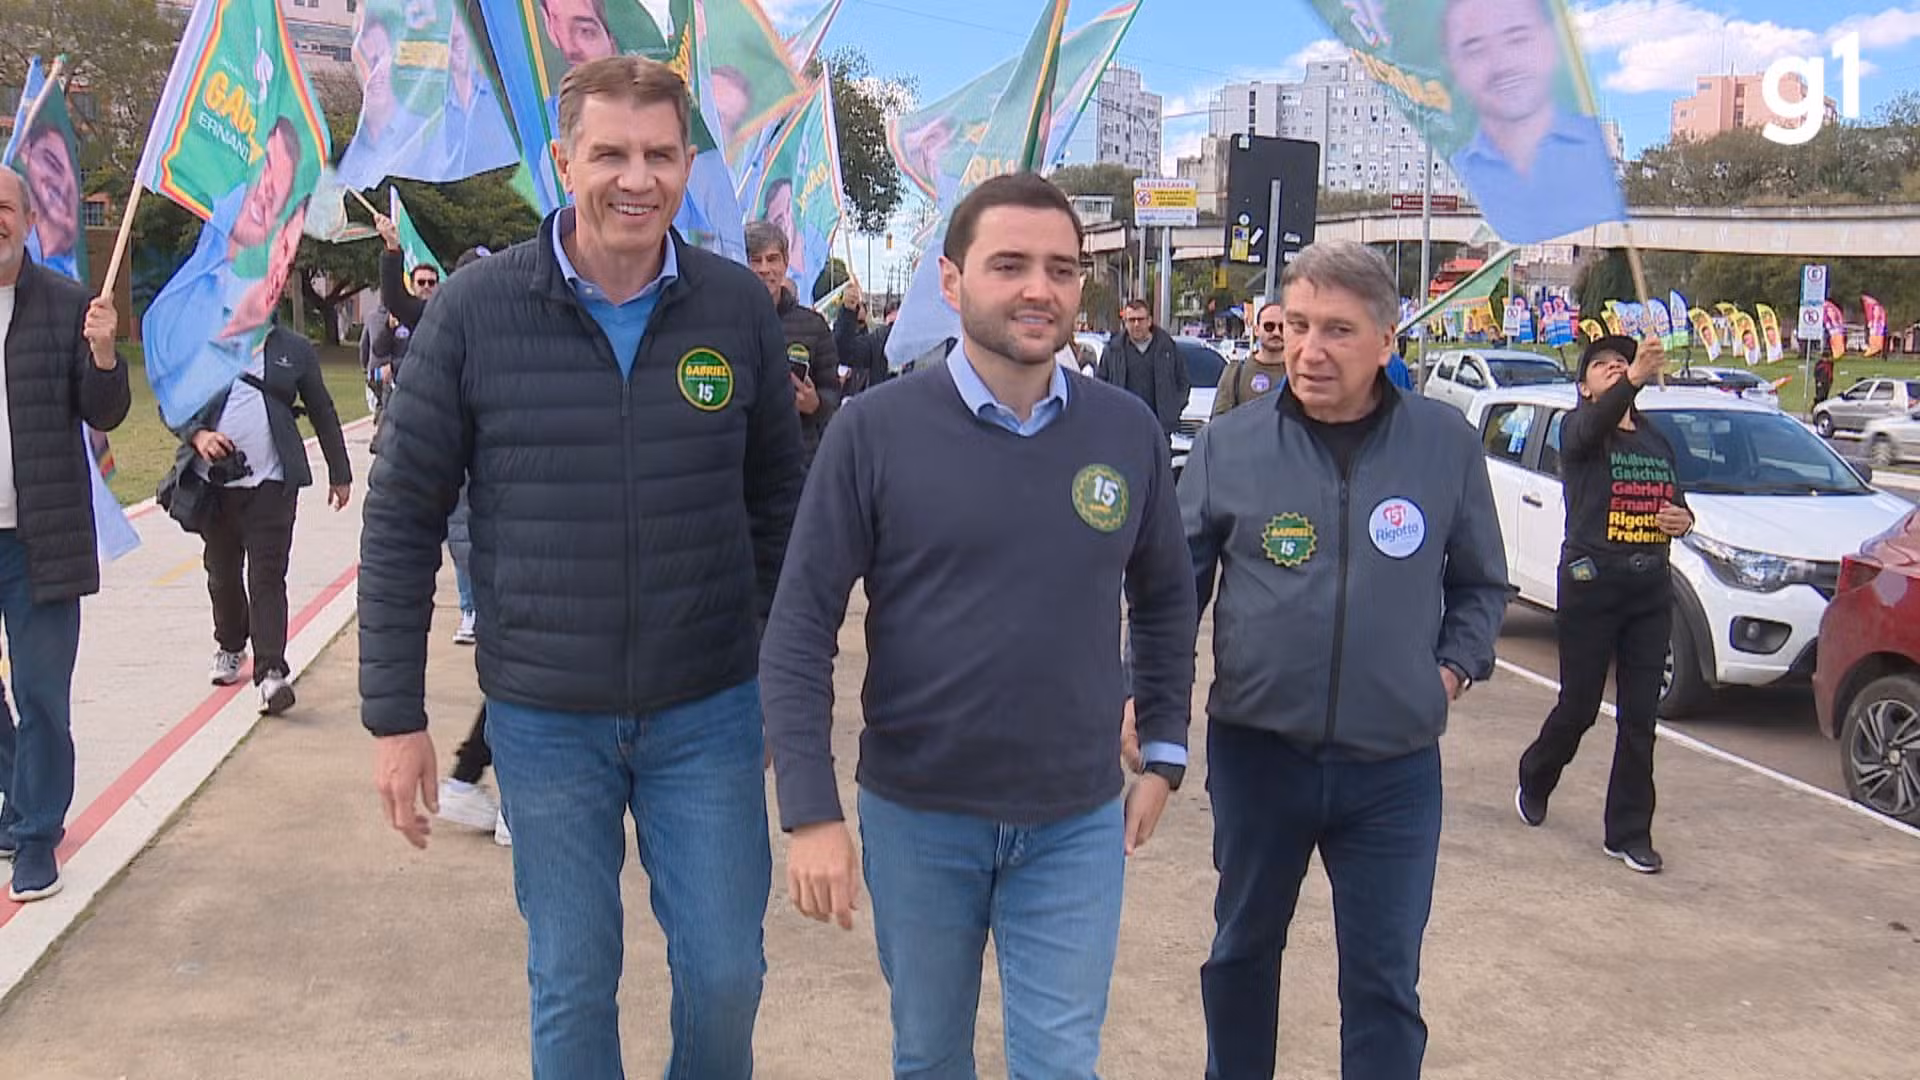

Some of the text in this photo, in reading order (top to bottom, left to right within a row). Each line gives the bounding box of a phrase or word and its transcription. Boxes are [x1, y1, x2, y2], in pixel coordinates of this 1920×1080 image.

[685, 365, 729, 378] GABRIEL
[697, 382, 715, 403] 15
[1094, 475, 1119, 507] 15
[1611, 481, 1664, 497] Gabriel
[1610, 498, 1657, 512] Ernani
[1608, 511, 1658, 530] Rigott
[1375, 521, 1420, 544] Rigotto
[1280, 540, 1296, 557] 15
